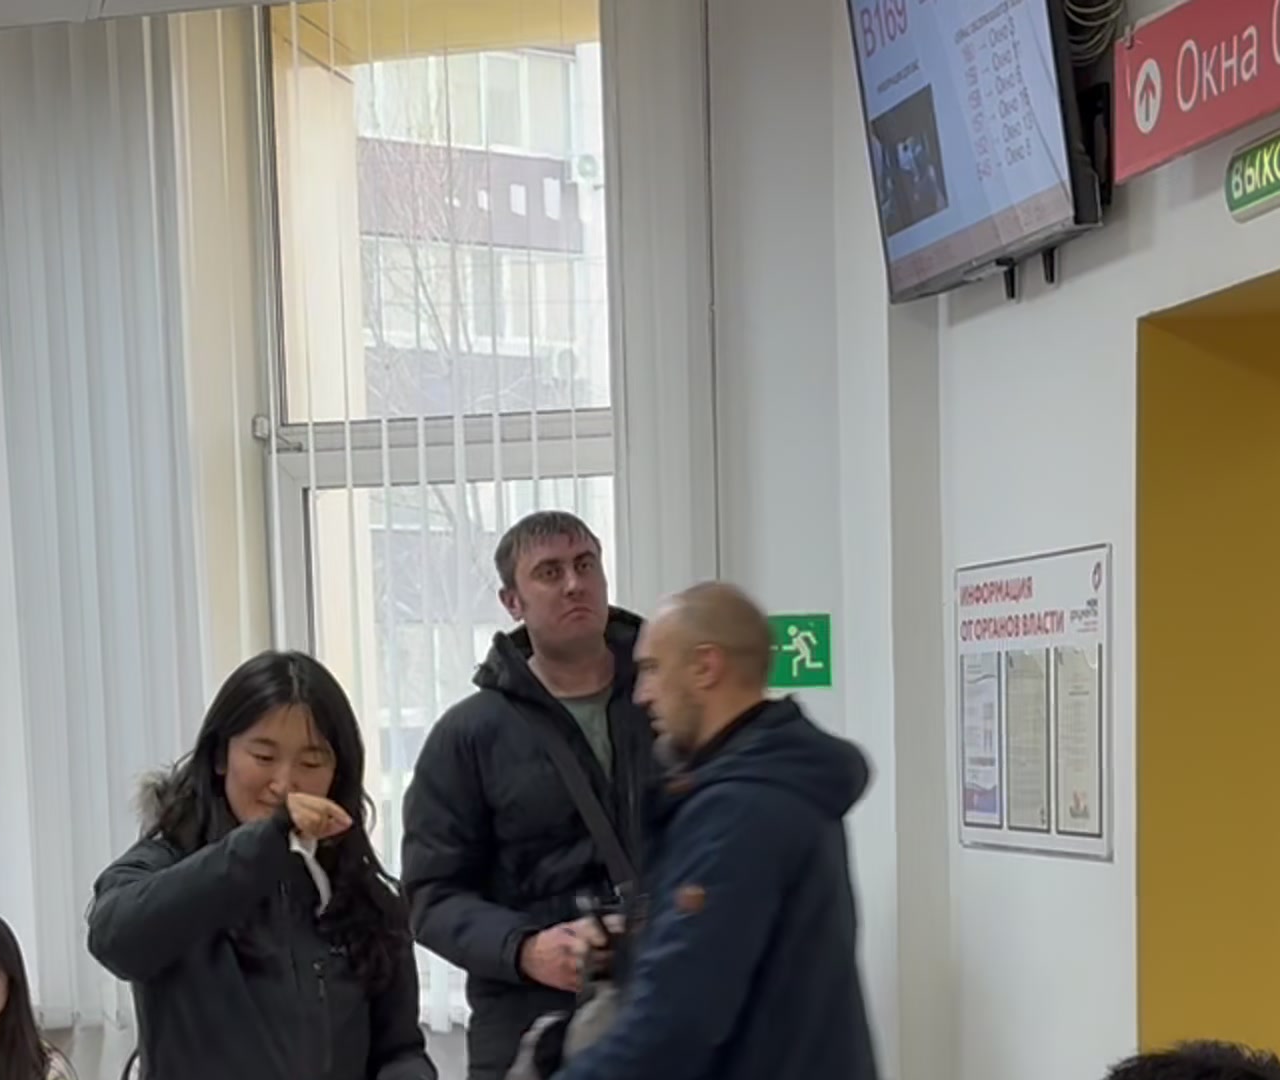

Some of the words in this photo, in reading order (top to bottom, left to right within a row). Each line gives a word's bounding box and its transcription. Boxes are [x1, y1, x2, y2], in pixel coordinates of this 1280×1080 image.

[1176, 25, 1258, 112] Окна
[959, 575, 1033, 607] ИНФОРМАЦИЯ
[1022, 609, 1065, 637] ВЛАСТИ
